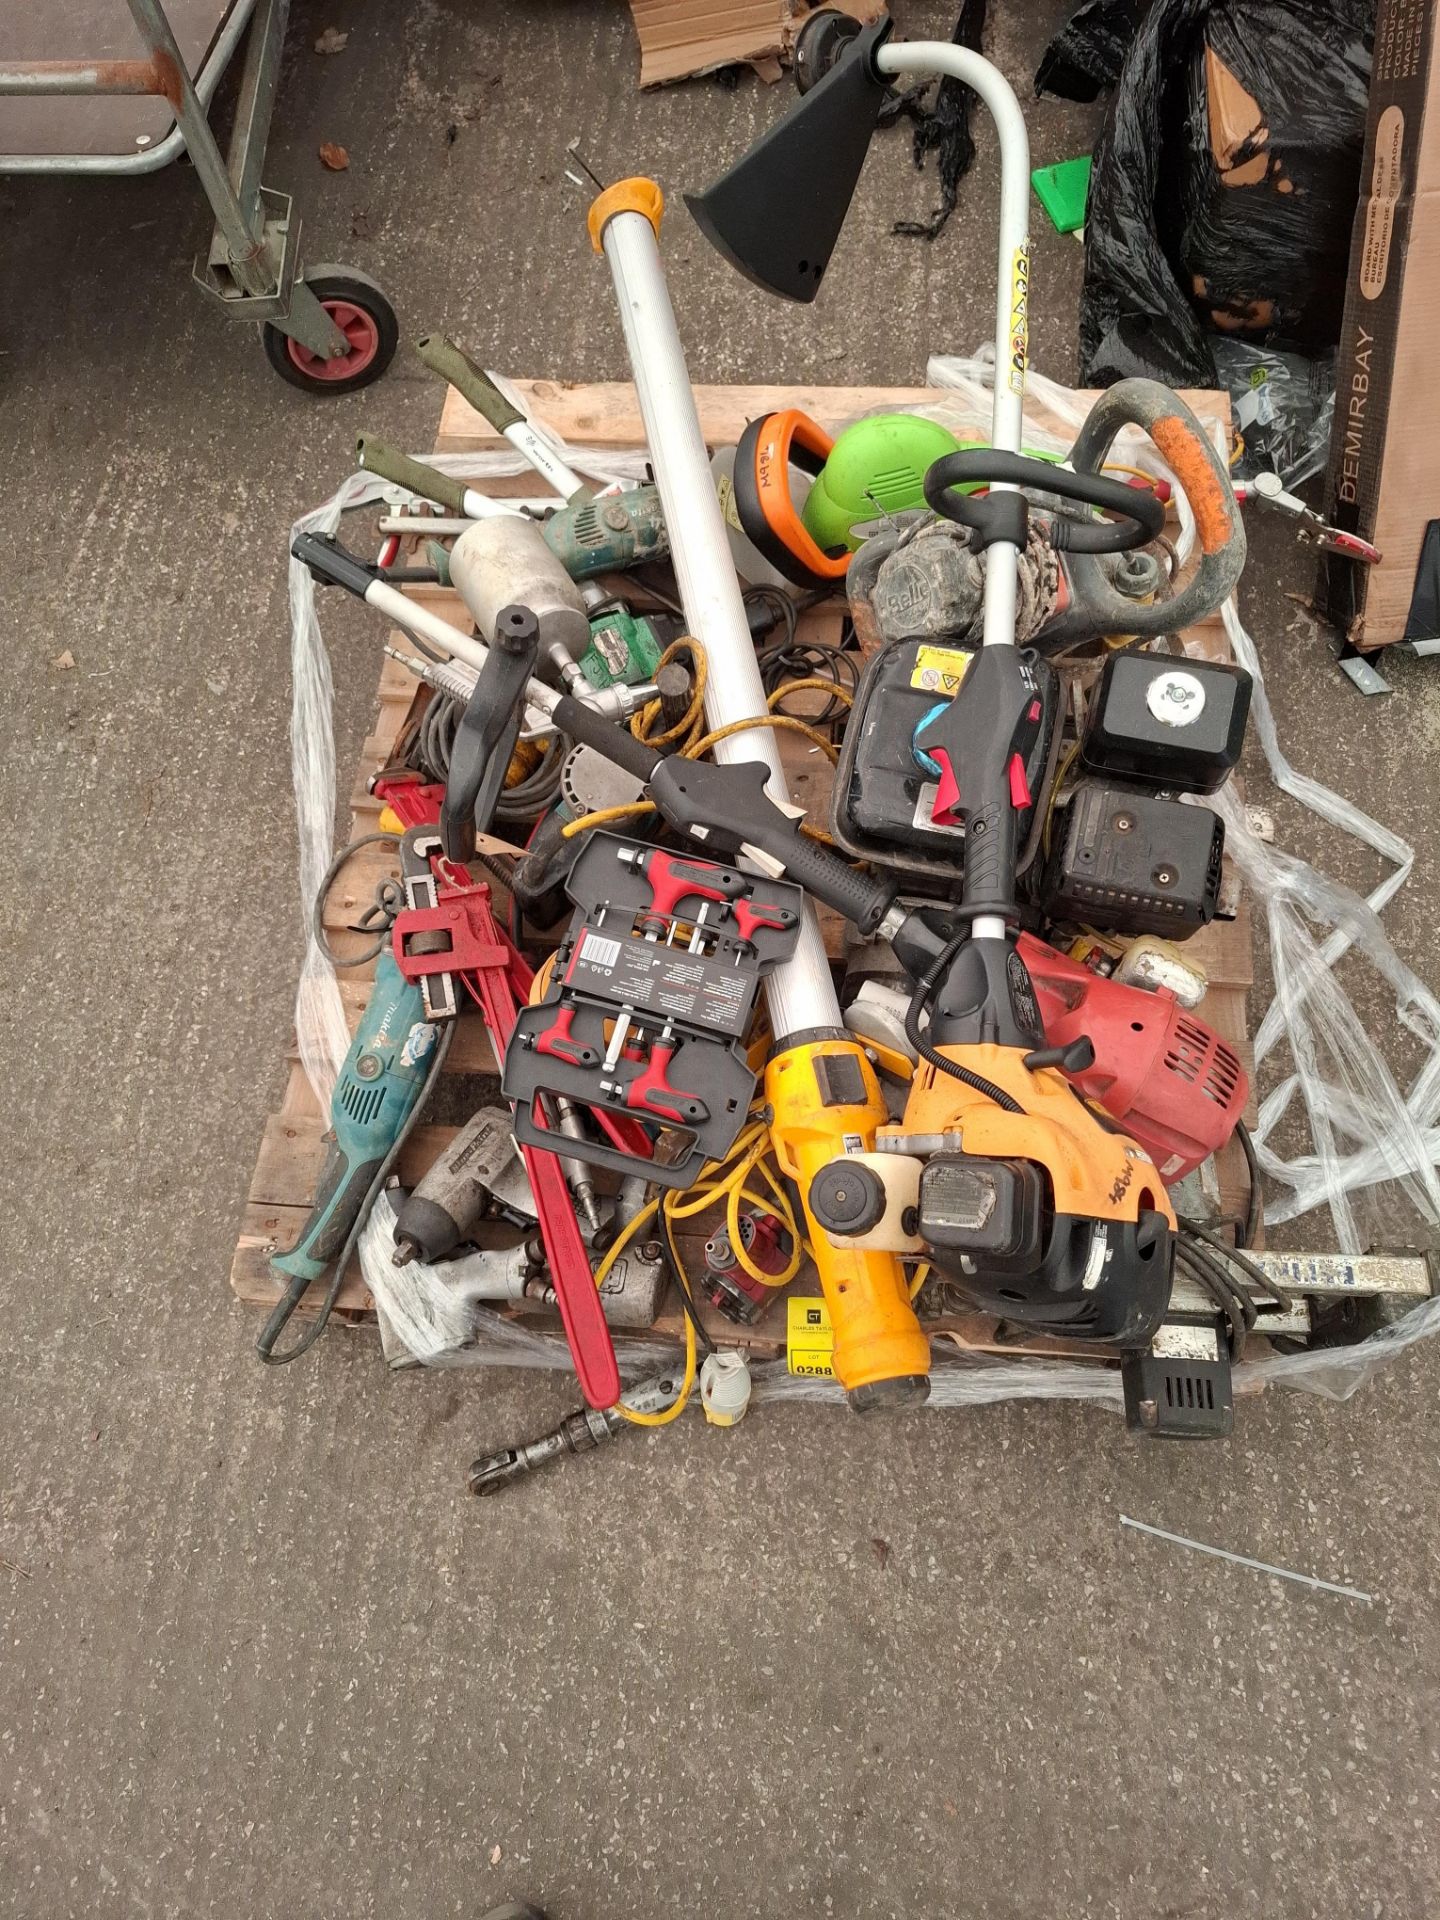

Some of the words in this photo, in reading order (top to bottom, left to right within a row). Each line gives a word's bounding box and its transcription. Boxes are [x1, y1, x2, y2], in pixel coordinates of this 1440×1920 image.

[1402, 28, 1414, 78] MADE
[1408, 7, 1416, 23] IN
[1411, 11, 1425, 76] PIECES
[1376, 47, 1385, 81] SKU
[1364, 247, 1372, 282] BOARD
[1370, 242, 1380, 284] BUREAU
[1377, 222, 1389, 284] ESCRITORIO
[1384, 207, 1390, 220] DE
[1339, 325, 1374, 502] DEMIRBAY
[808, 1312, 820, 1321] CT
[796, 1365, 833, 1376] 0288
